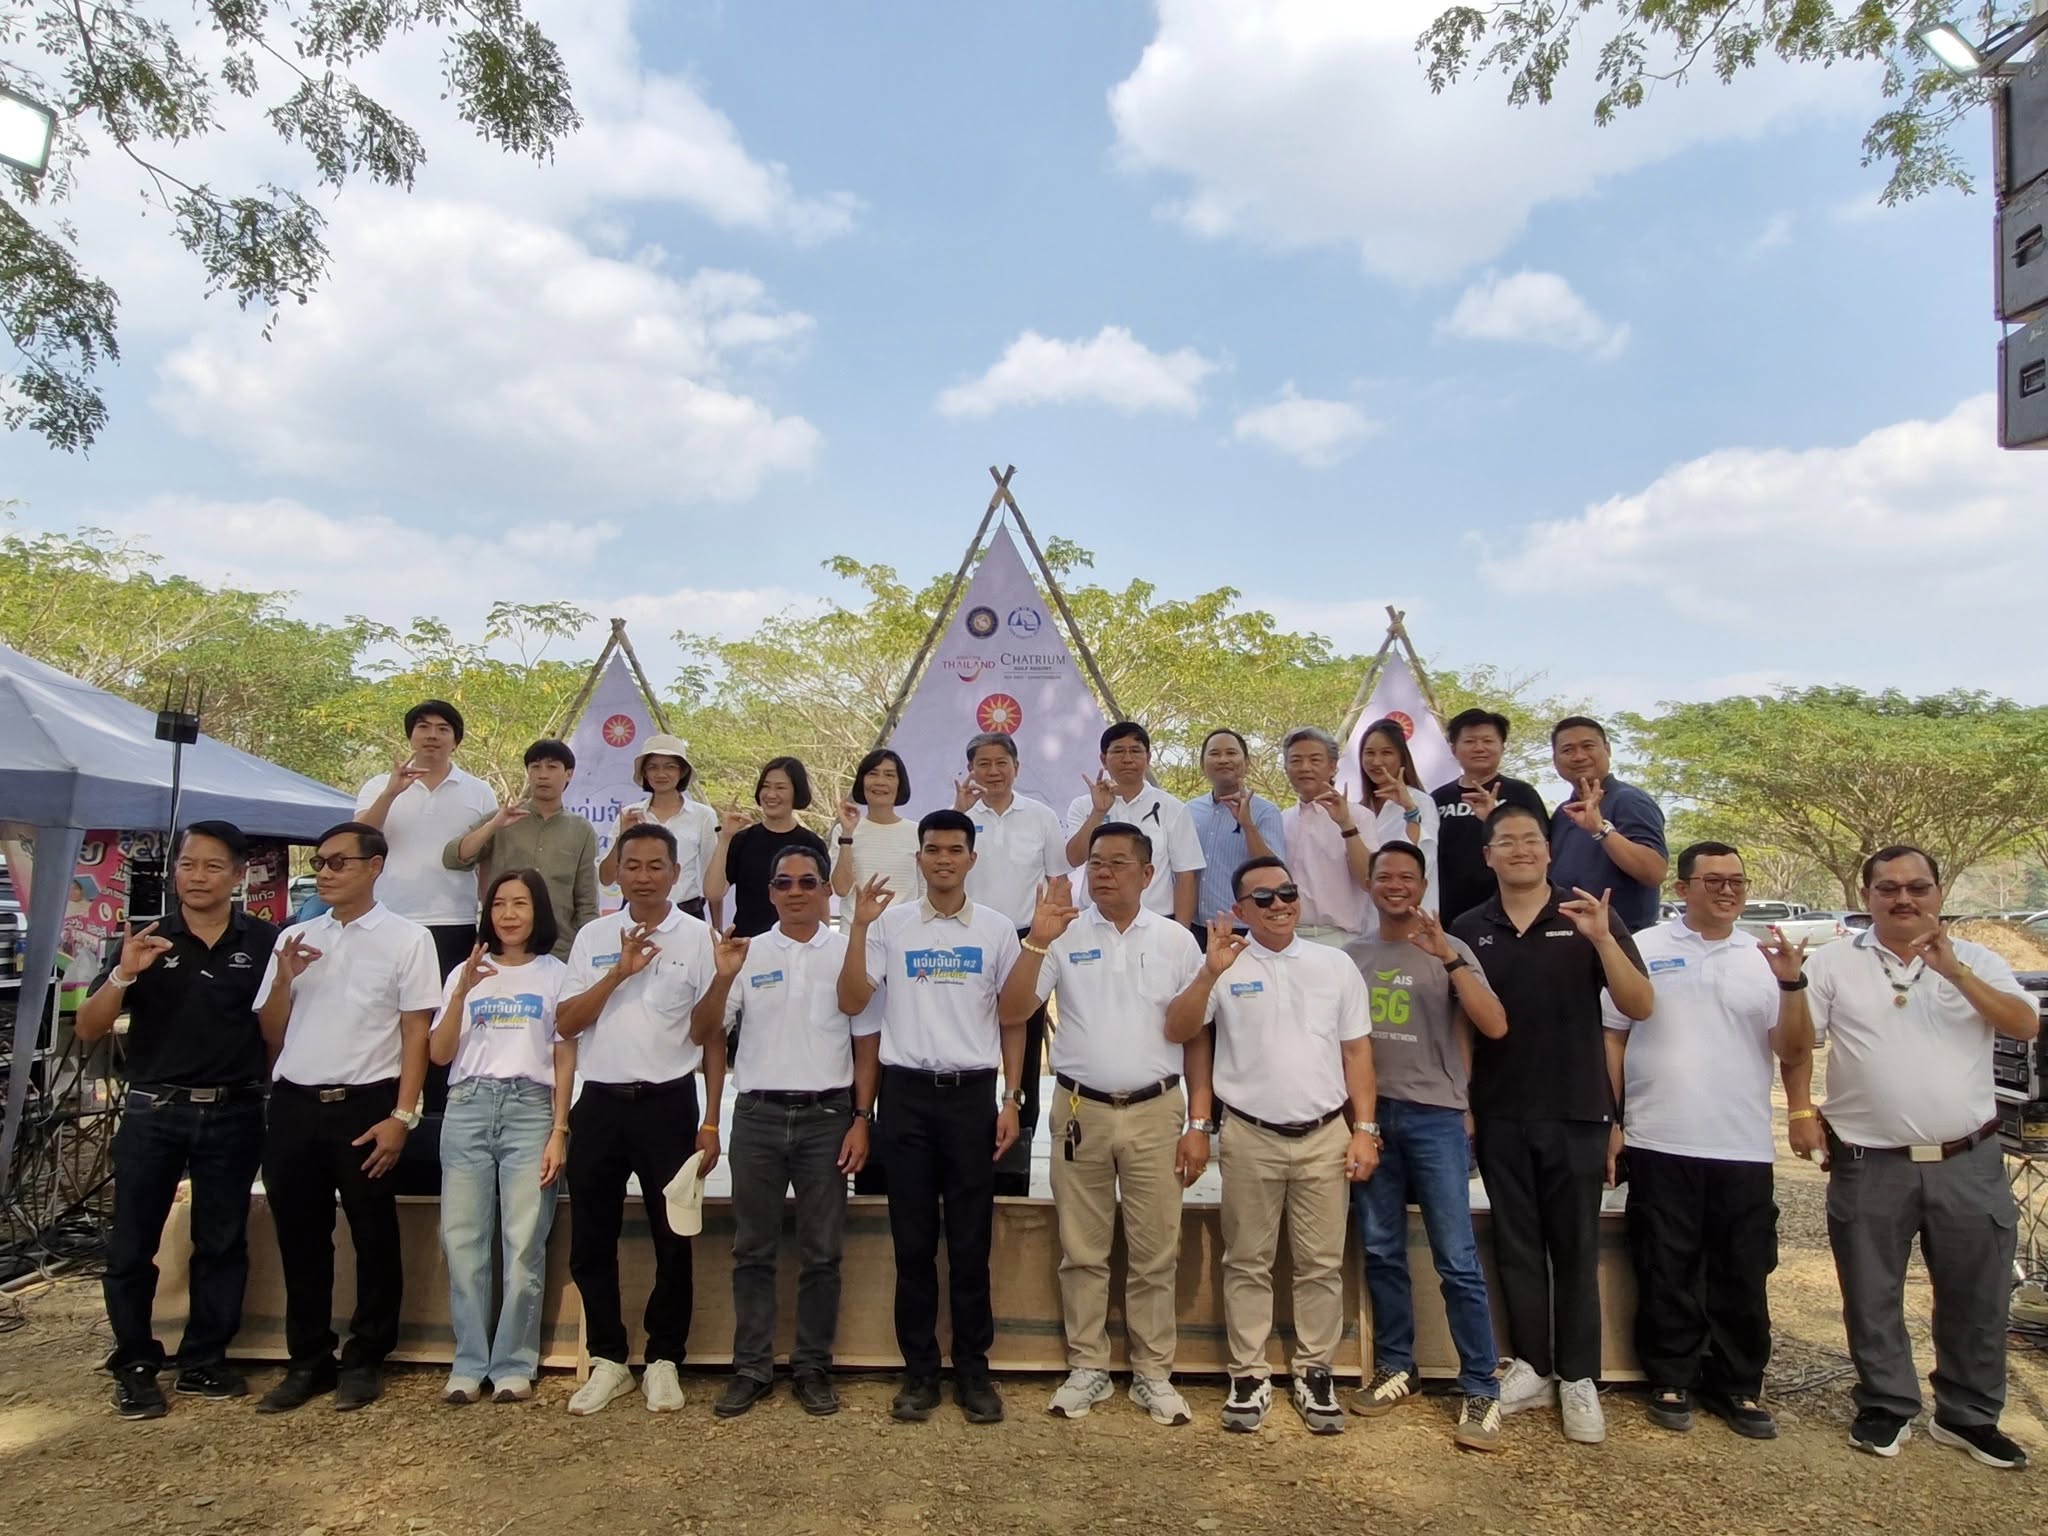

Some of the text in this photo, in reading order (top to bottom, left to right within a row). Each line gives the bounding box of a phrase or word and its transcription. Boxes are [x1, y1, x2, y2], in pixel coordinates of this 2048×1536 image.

[943, 660, 996, 669] THAILAND
[1392, 975, 1414, 986] AIS
[1371, 987, 1411, 1025] 5G
